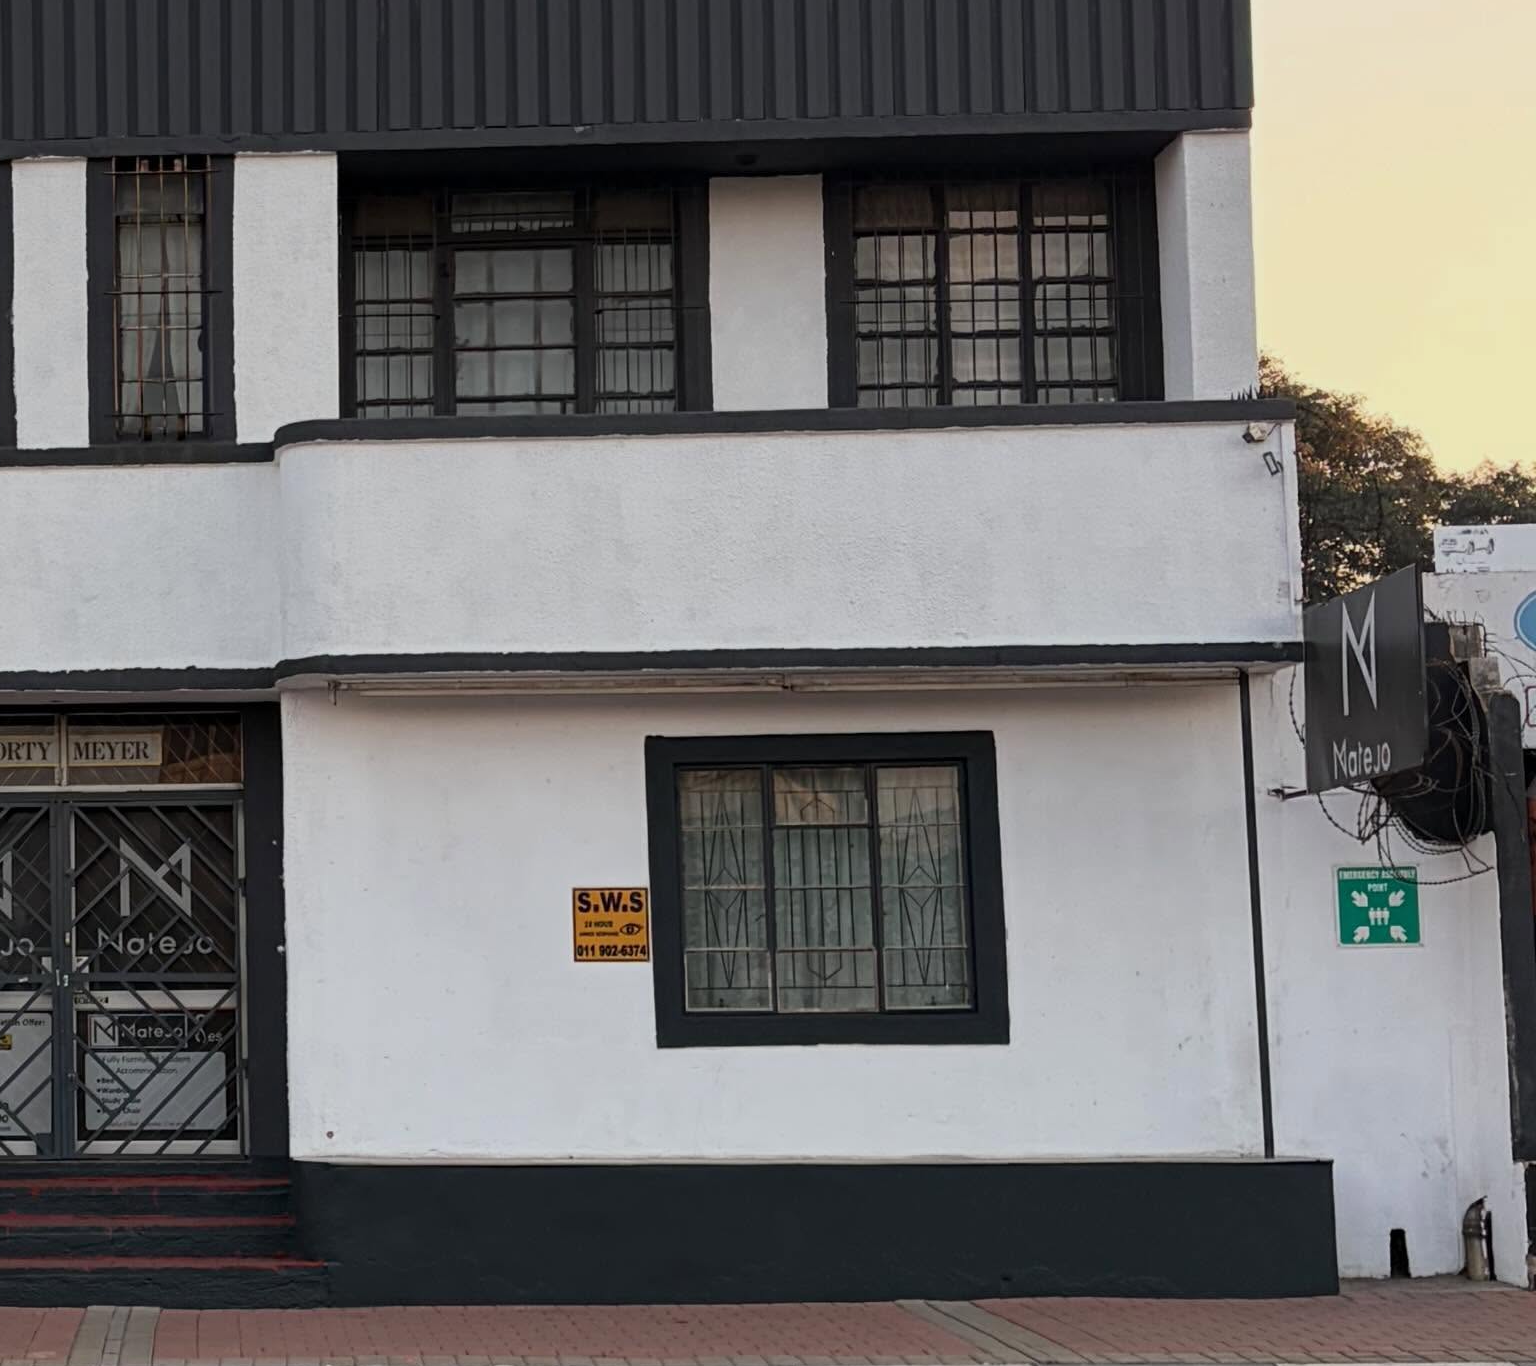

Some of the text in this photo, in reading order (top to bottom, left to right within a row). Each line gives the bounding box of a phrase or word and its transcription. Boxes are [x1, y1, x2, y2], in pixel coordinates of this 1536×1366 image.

[73, 740, 150, 761] MEYER
[1367, 882, 1388, 892] POINT
[577, 891, 644, 913] S.W.S
[577, 945, 595, 957] 011
